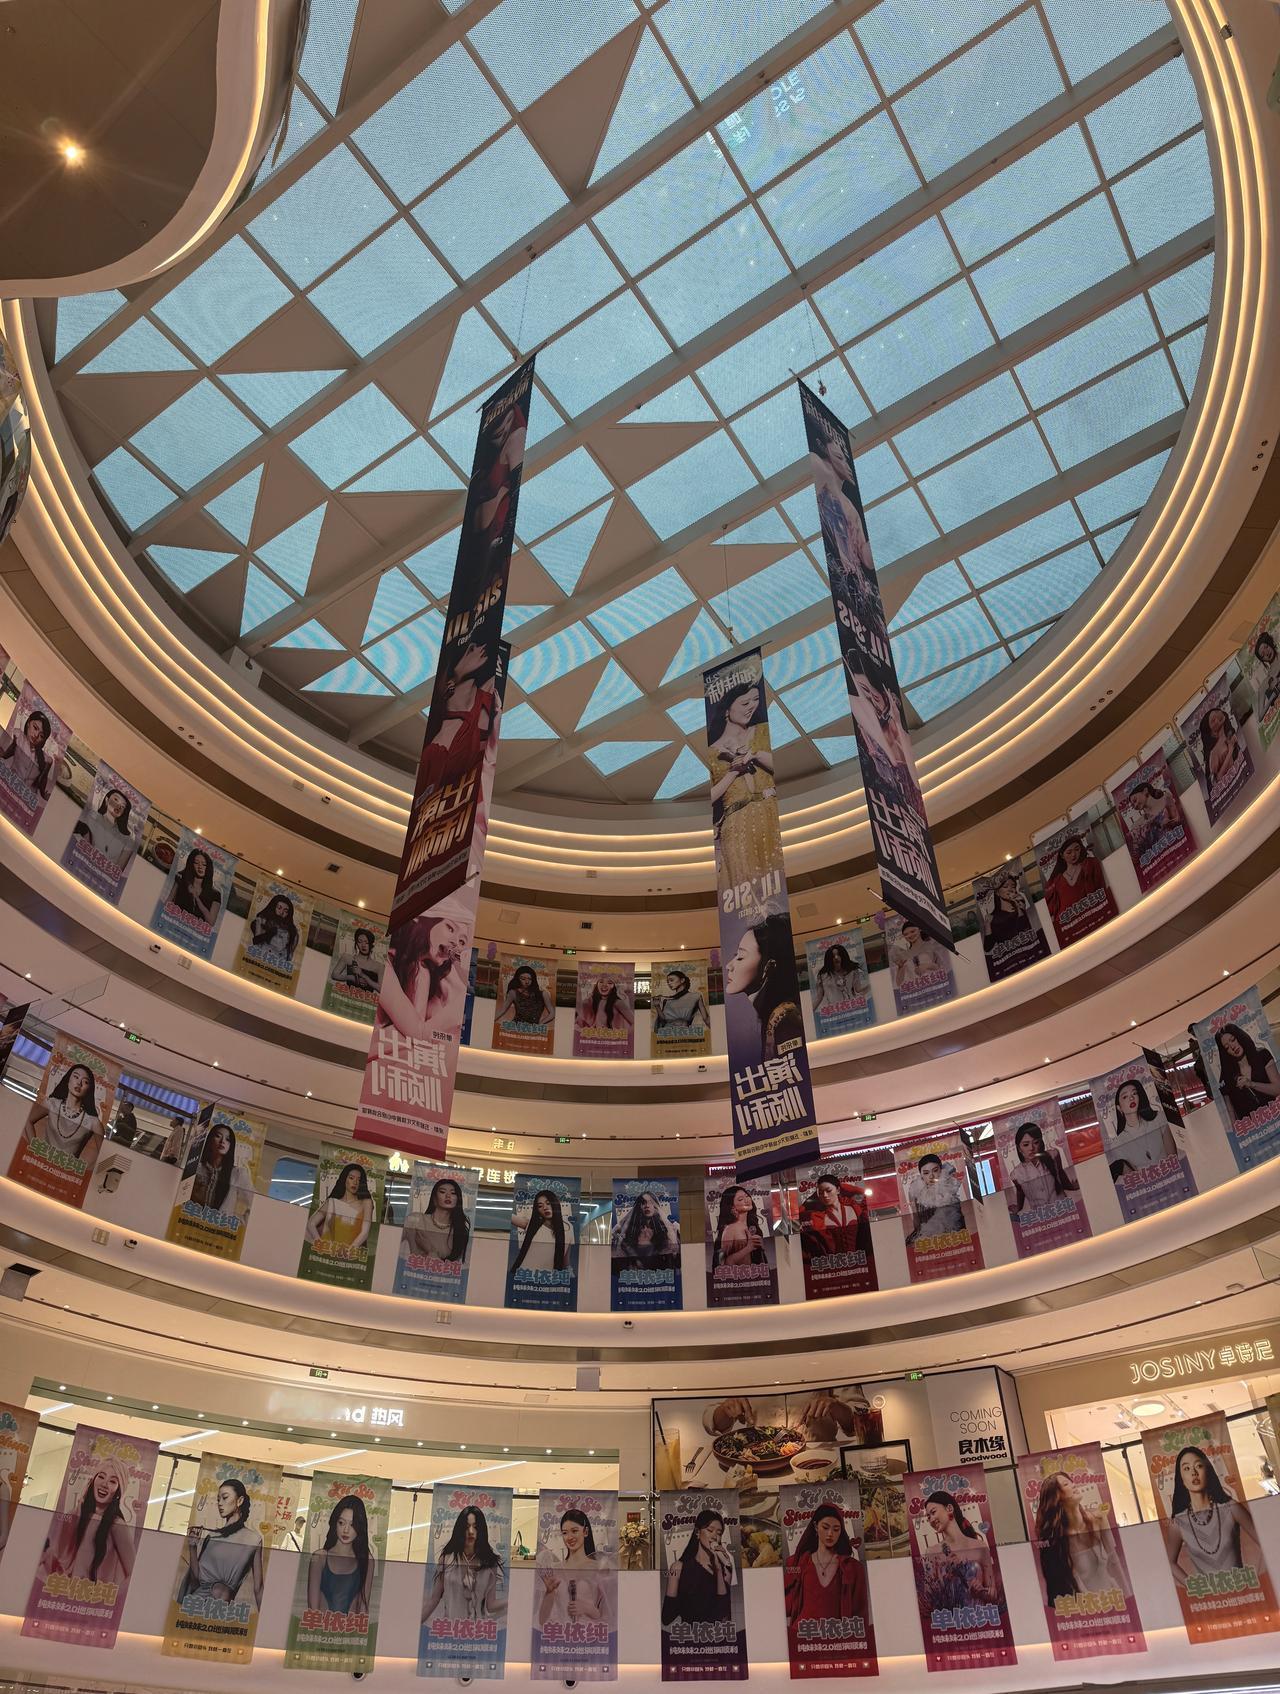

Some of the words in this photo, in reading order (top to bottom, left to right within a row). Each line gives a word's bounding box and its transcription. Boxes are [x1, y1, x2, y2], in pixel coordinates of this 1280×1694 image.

[1130, 1349, 1215, 1384] JOSINY
[1219, 1338, 1275, 1367] 卓诗尼
[371, 1407, 404, 1427] 热风
[950, 1406, 1002, 1422] COMING
[960, 1420, 996, 1434] SOON
[959, 1436, 1006, 1455] 良木缘
[960, 1452, 1007, 1464] goodwood
[301, 1610, 370, 1635] 单依纯
[931, 1604, 1001, 1631] 单依纯
[429, 1618, 498, 1640] 单依纯
[541, 1623, 609, 1644] 单依纯
[669, 1621, 738, 1644] 单依纯
[797, 1616, 866, 1641] 单依纯
